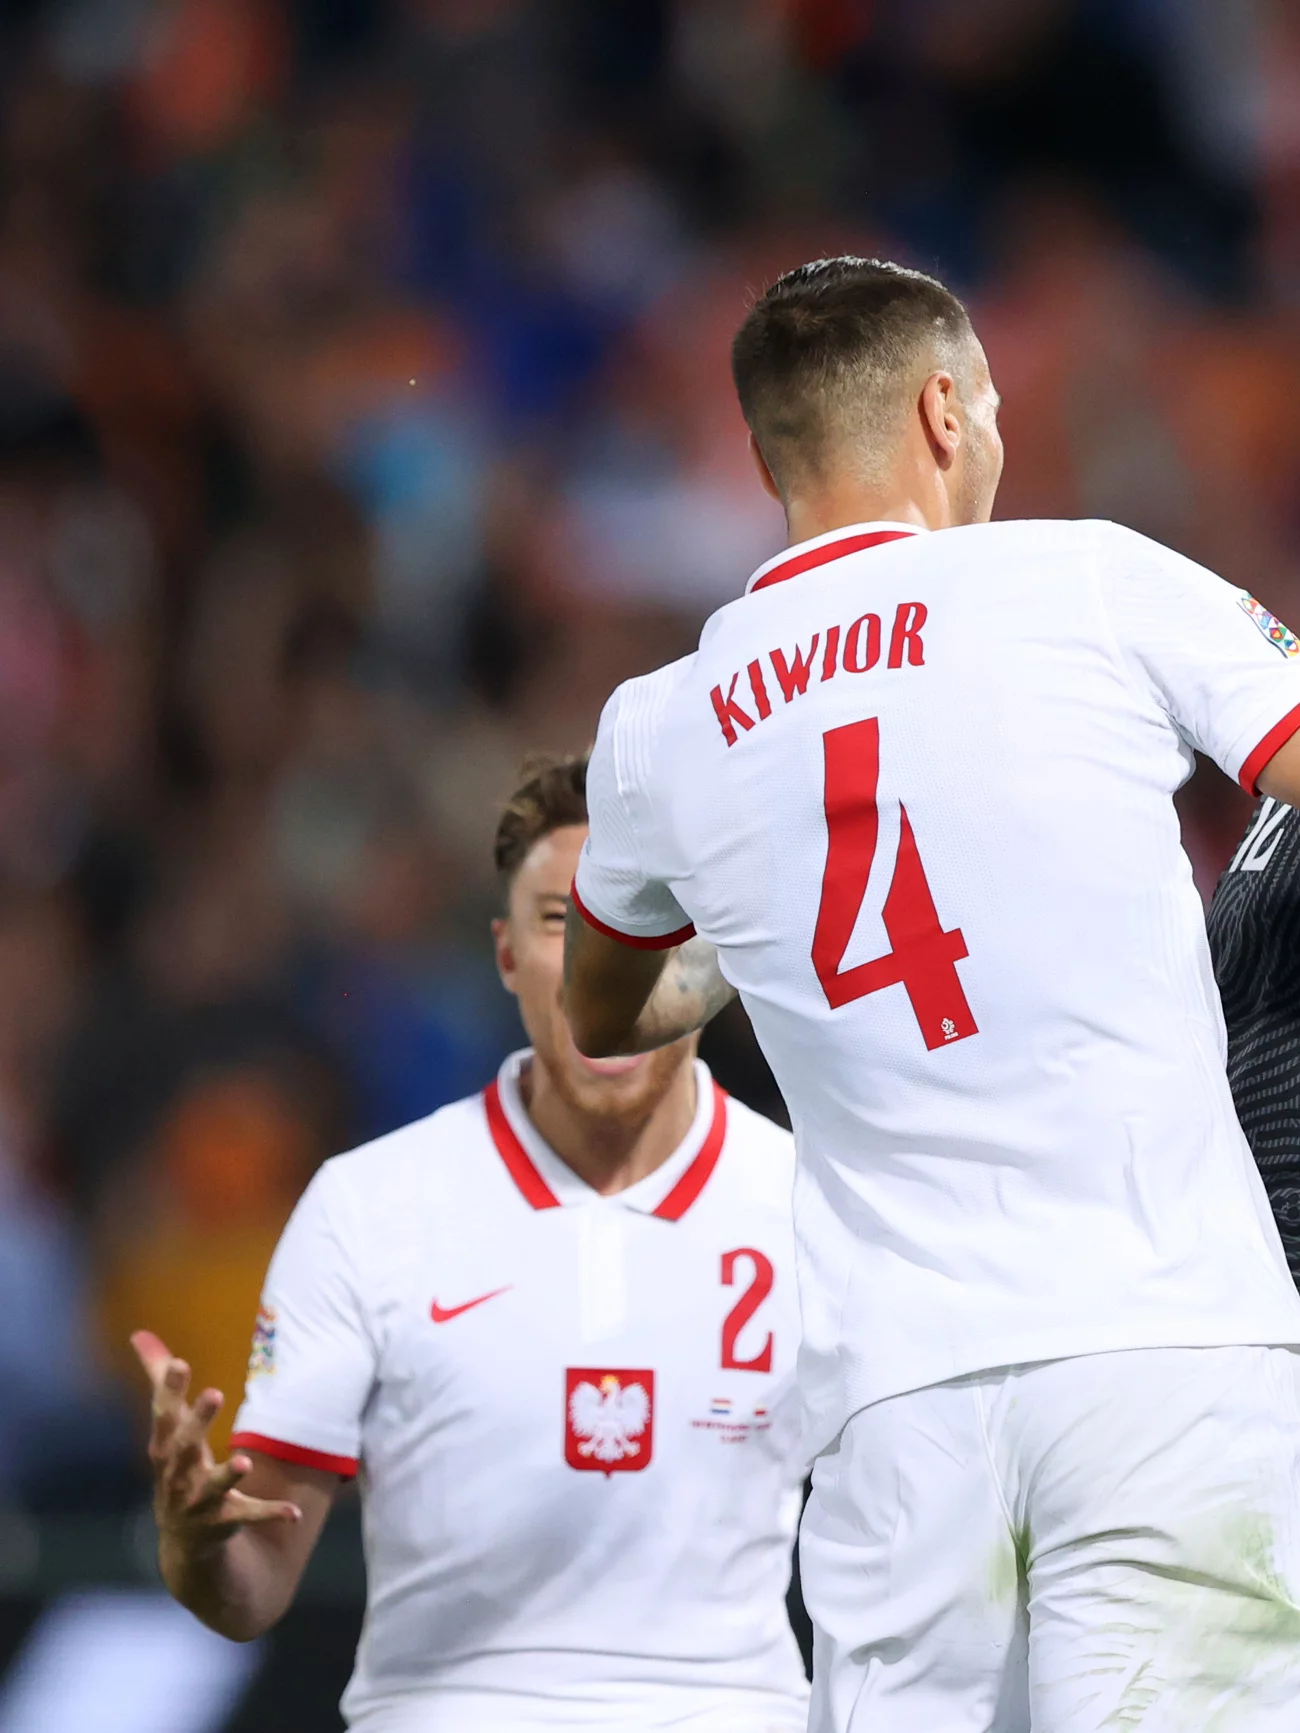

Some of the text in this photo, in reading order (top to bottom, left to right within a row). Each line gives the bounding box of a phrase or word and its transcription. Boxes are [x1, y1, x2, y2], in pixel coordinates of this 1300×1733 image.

[710, 601, 928, 748] KIWIOR
[810, 716, 979, 1051] 4
[720, 1247, 774, 1374] 2
